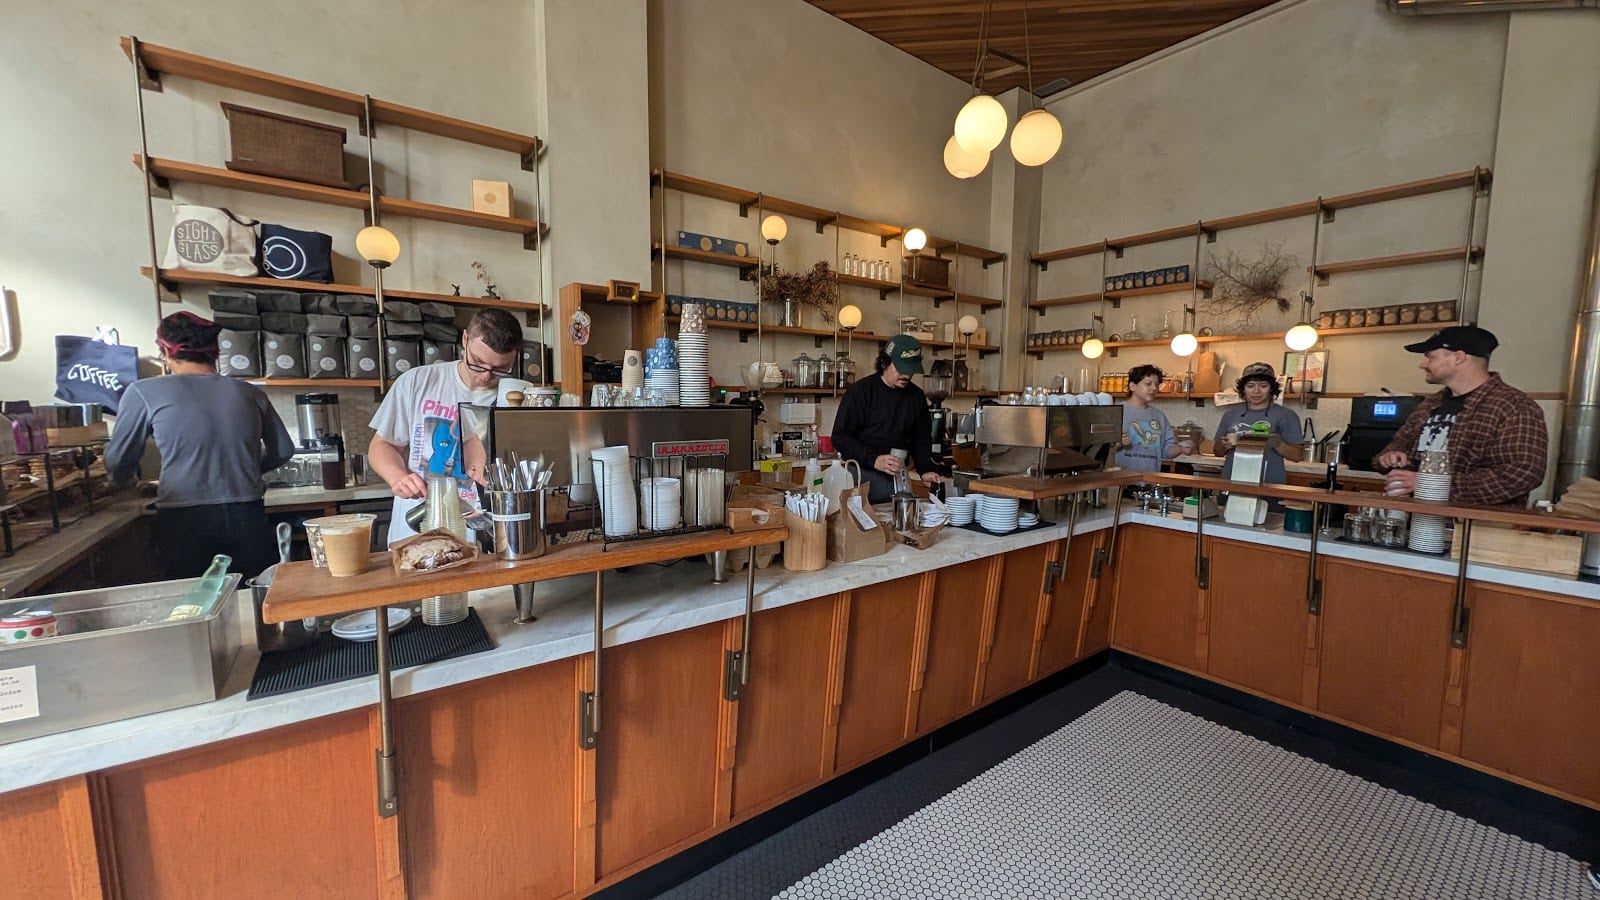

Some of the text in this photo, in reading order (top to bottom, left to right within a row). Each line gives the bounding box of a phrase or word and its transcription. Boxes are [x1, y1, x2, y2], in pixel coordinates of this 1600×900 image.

[177, 221, 217, 240] SIGHT
[178, 242, 218, 261] GLASS
[67, 364, 122, 391] COFFEE
[422, 399, 459, 420] Pink
